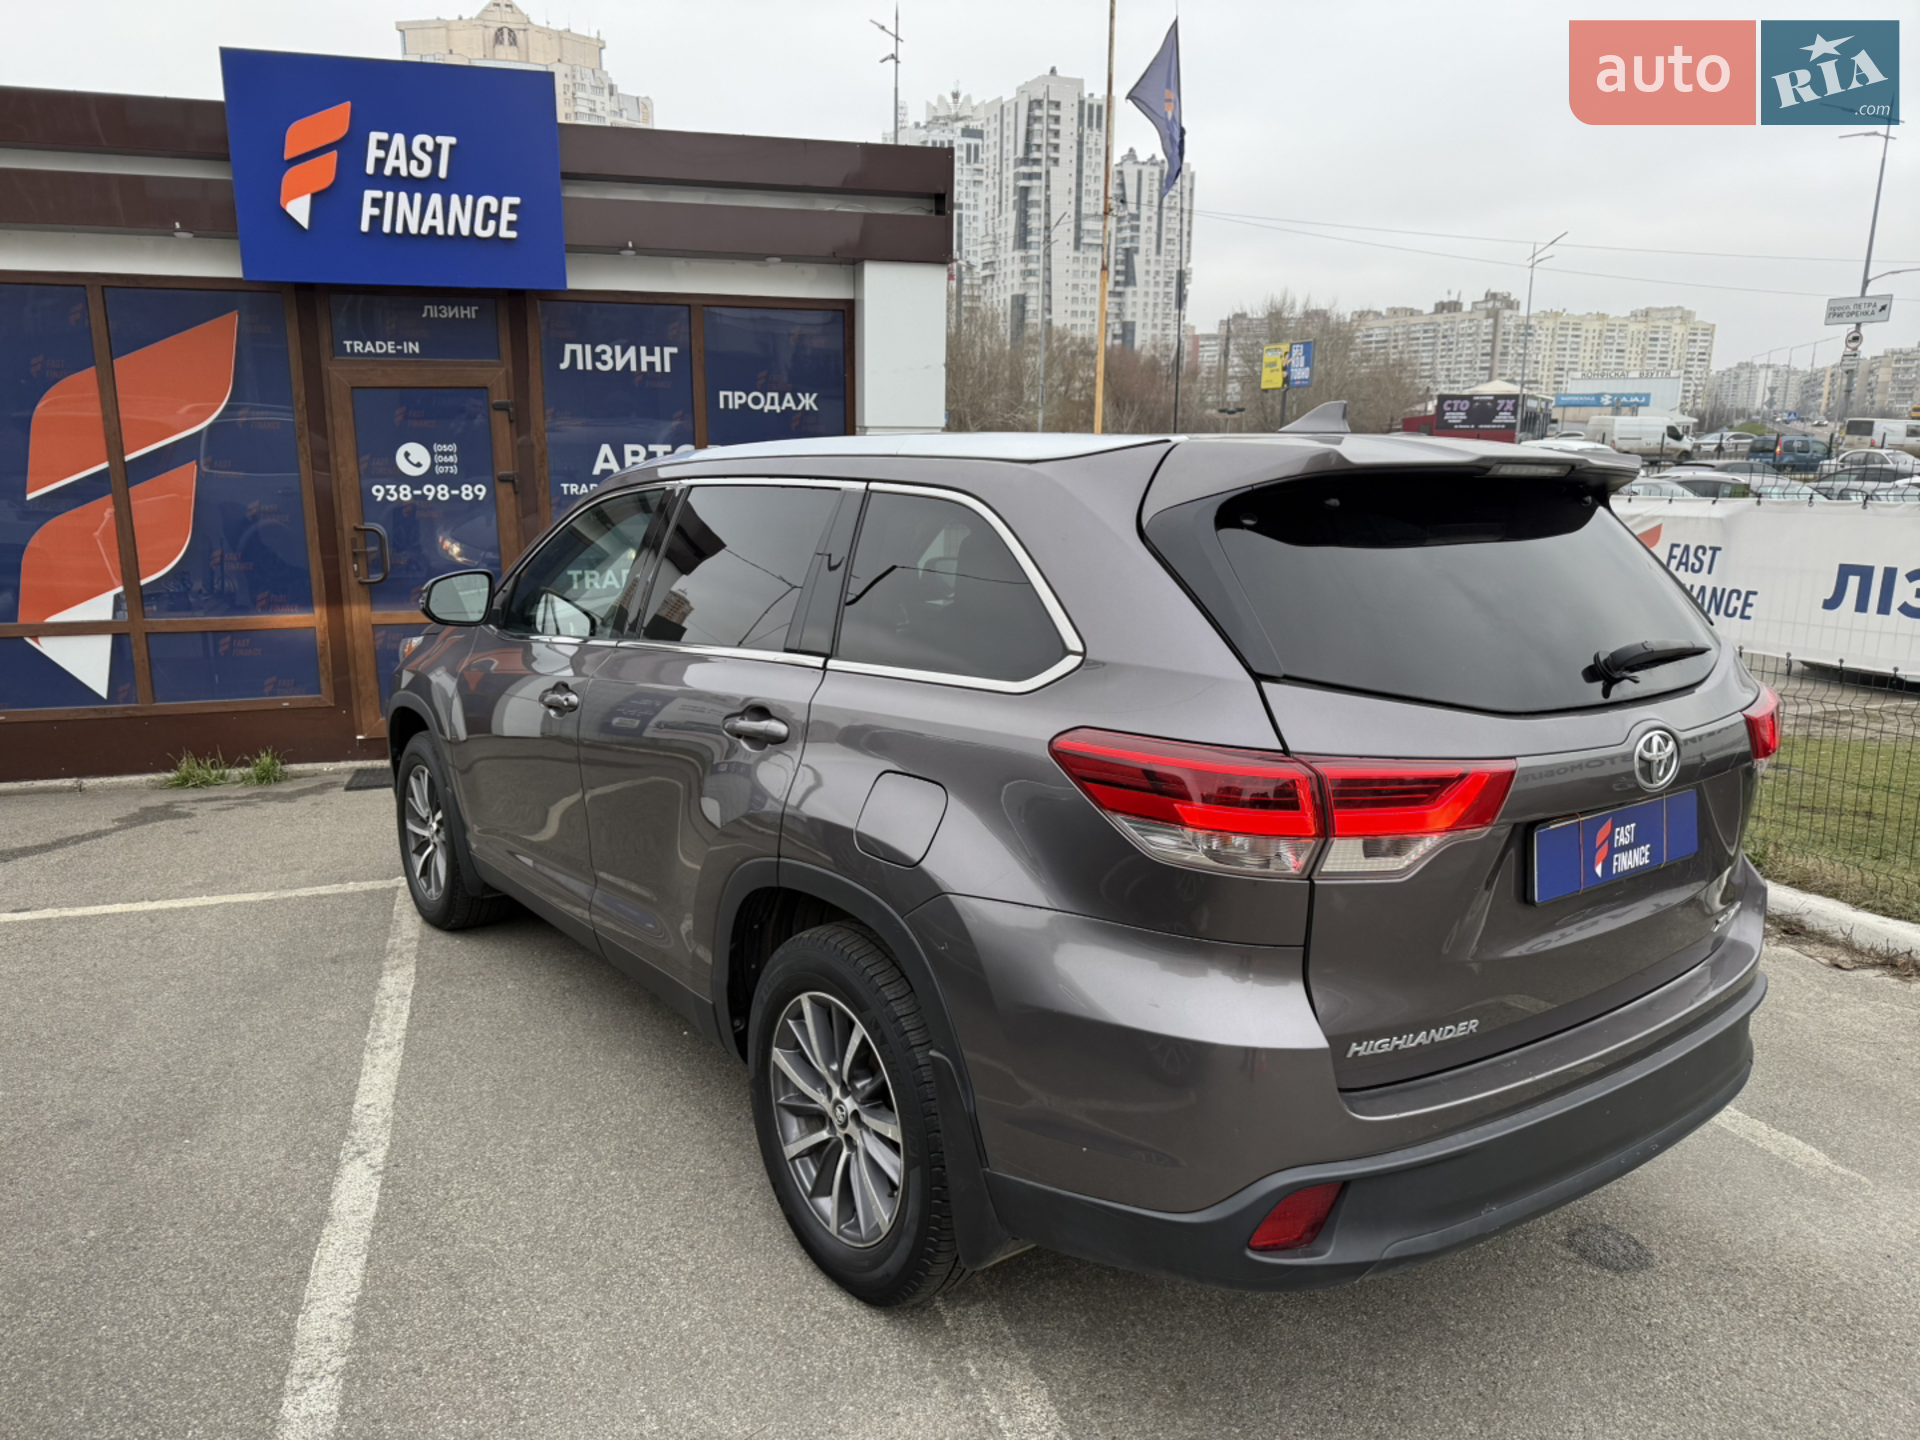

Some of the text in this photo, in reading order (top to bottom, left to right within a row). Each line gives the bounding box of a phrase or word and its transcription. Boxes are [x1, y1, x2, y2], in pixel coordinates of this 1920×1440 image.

[365, 131, 457, 179] FAST
[360, 189, 522, 239] FINANCE
[422, 304, 479, 319] ЛІЗИНГ
[1828, 309, 1876, 319] ГРИГОРЕНКА
[1853, 302, 1877, 310] ПЕТРА
[343, 340, 420, 354] TRADE-IN
[559, 343, 679, 373] ЛІЗИНГ
[718, 390, 819, 413] ПРОДАЖ
[1443, 399, 1471, 412] СТО
[435, 464, 458, 475] (073)
[591, 443, 722, 475] АВТ
[371, 484, 487, 501] 938-98-89
[1666, 543, 1722, 575] FAST
[1684, 584, 1758, 620] ANCE
[1614, 823, 1637, 849] FAST
[1612, 843, 1651, 875] FINANCE
[1346, 1019, 1480, 1058] HIGHLANDER
